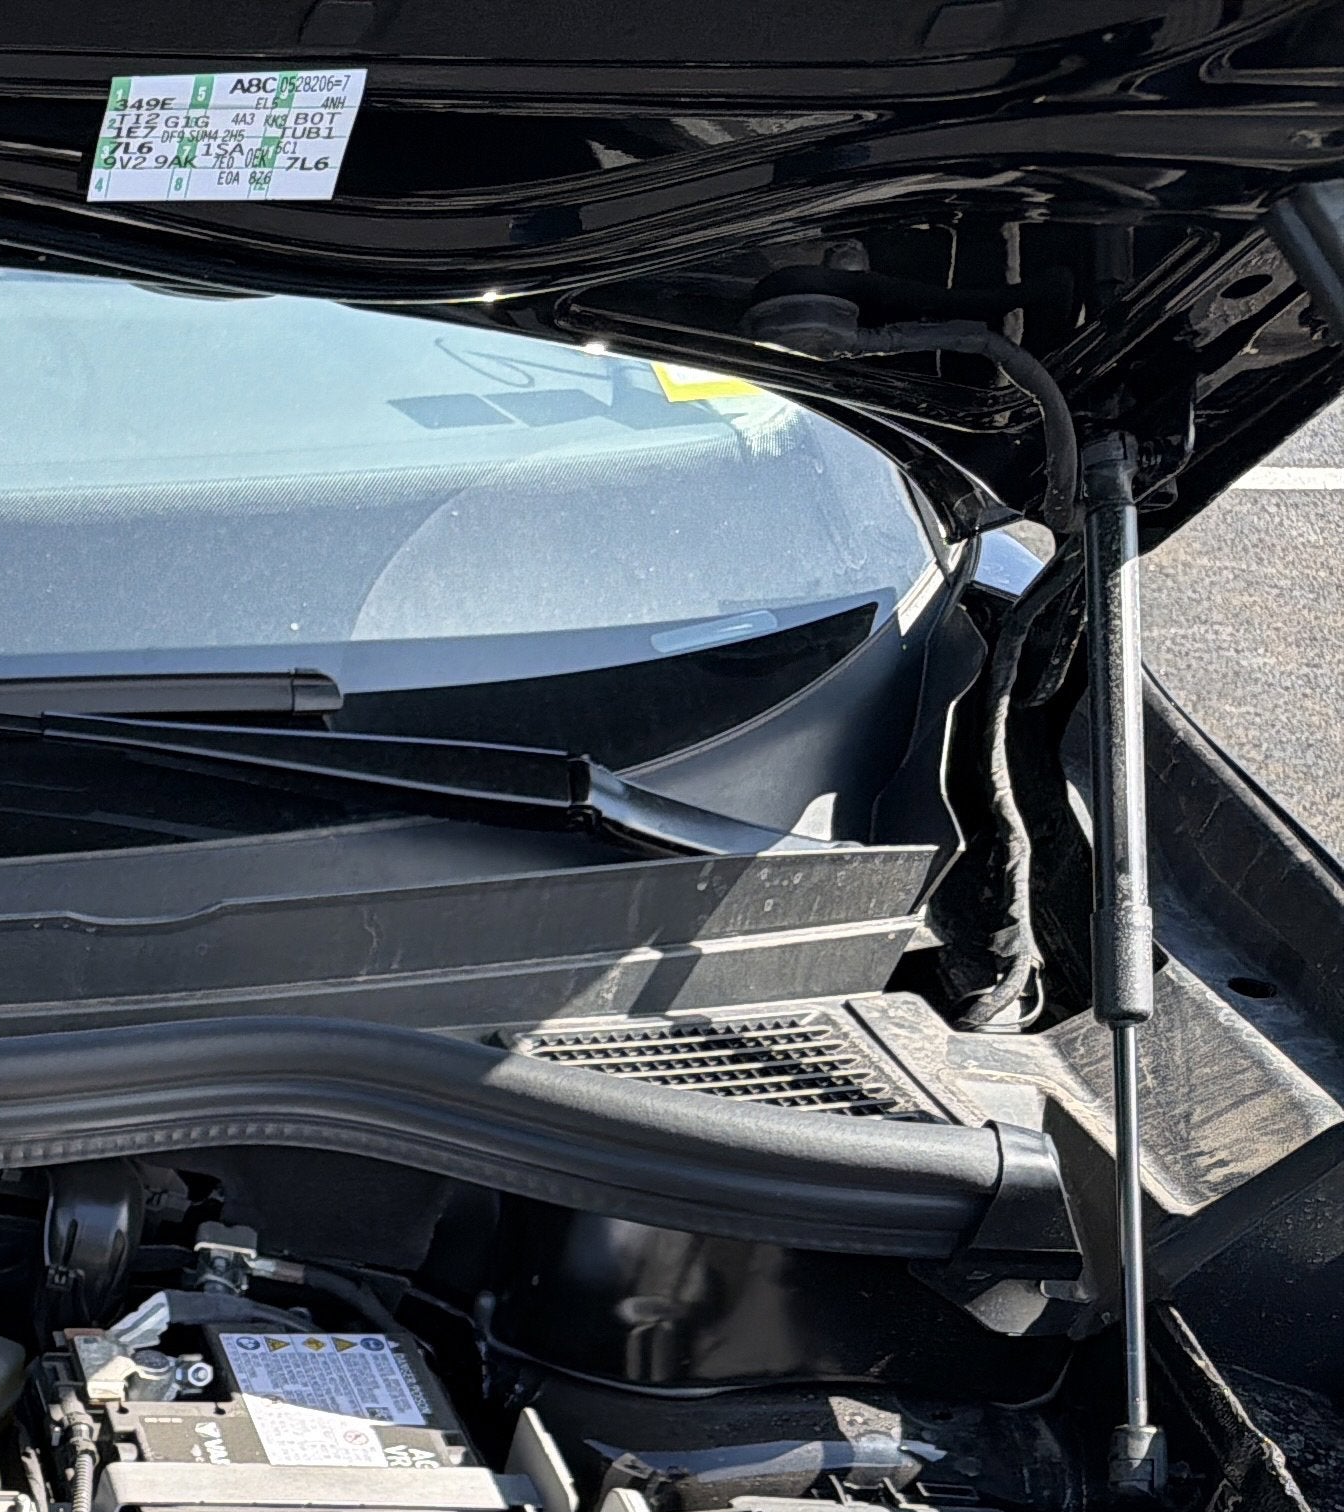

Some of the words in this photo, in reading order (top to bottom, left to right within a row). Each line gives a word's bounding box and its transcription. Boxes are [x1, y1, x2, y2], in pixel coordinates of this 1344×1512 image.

[196, 86, 207, 102] 5
[113, 97, 176, 111] 349E
[321, 96, 346, 109] 4NH
[231, 112, 256, 126] 4A3
[113, 126, 158, 139] 1E7
[109, 141, 153, 155] 7L6
[103, 156, 148, 169] 9V2
[154, 155, 197, 169] 9AK
[285, 156, 330, 171] 7L6
[95, 177, 103, 192] 4
[174, 176, 183, 191] 8
